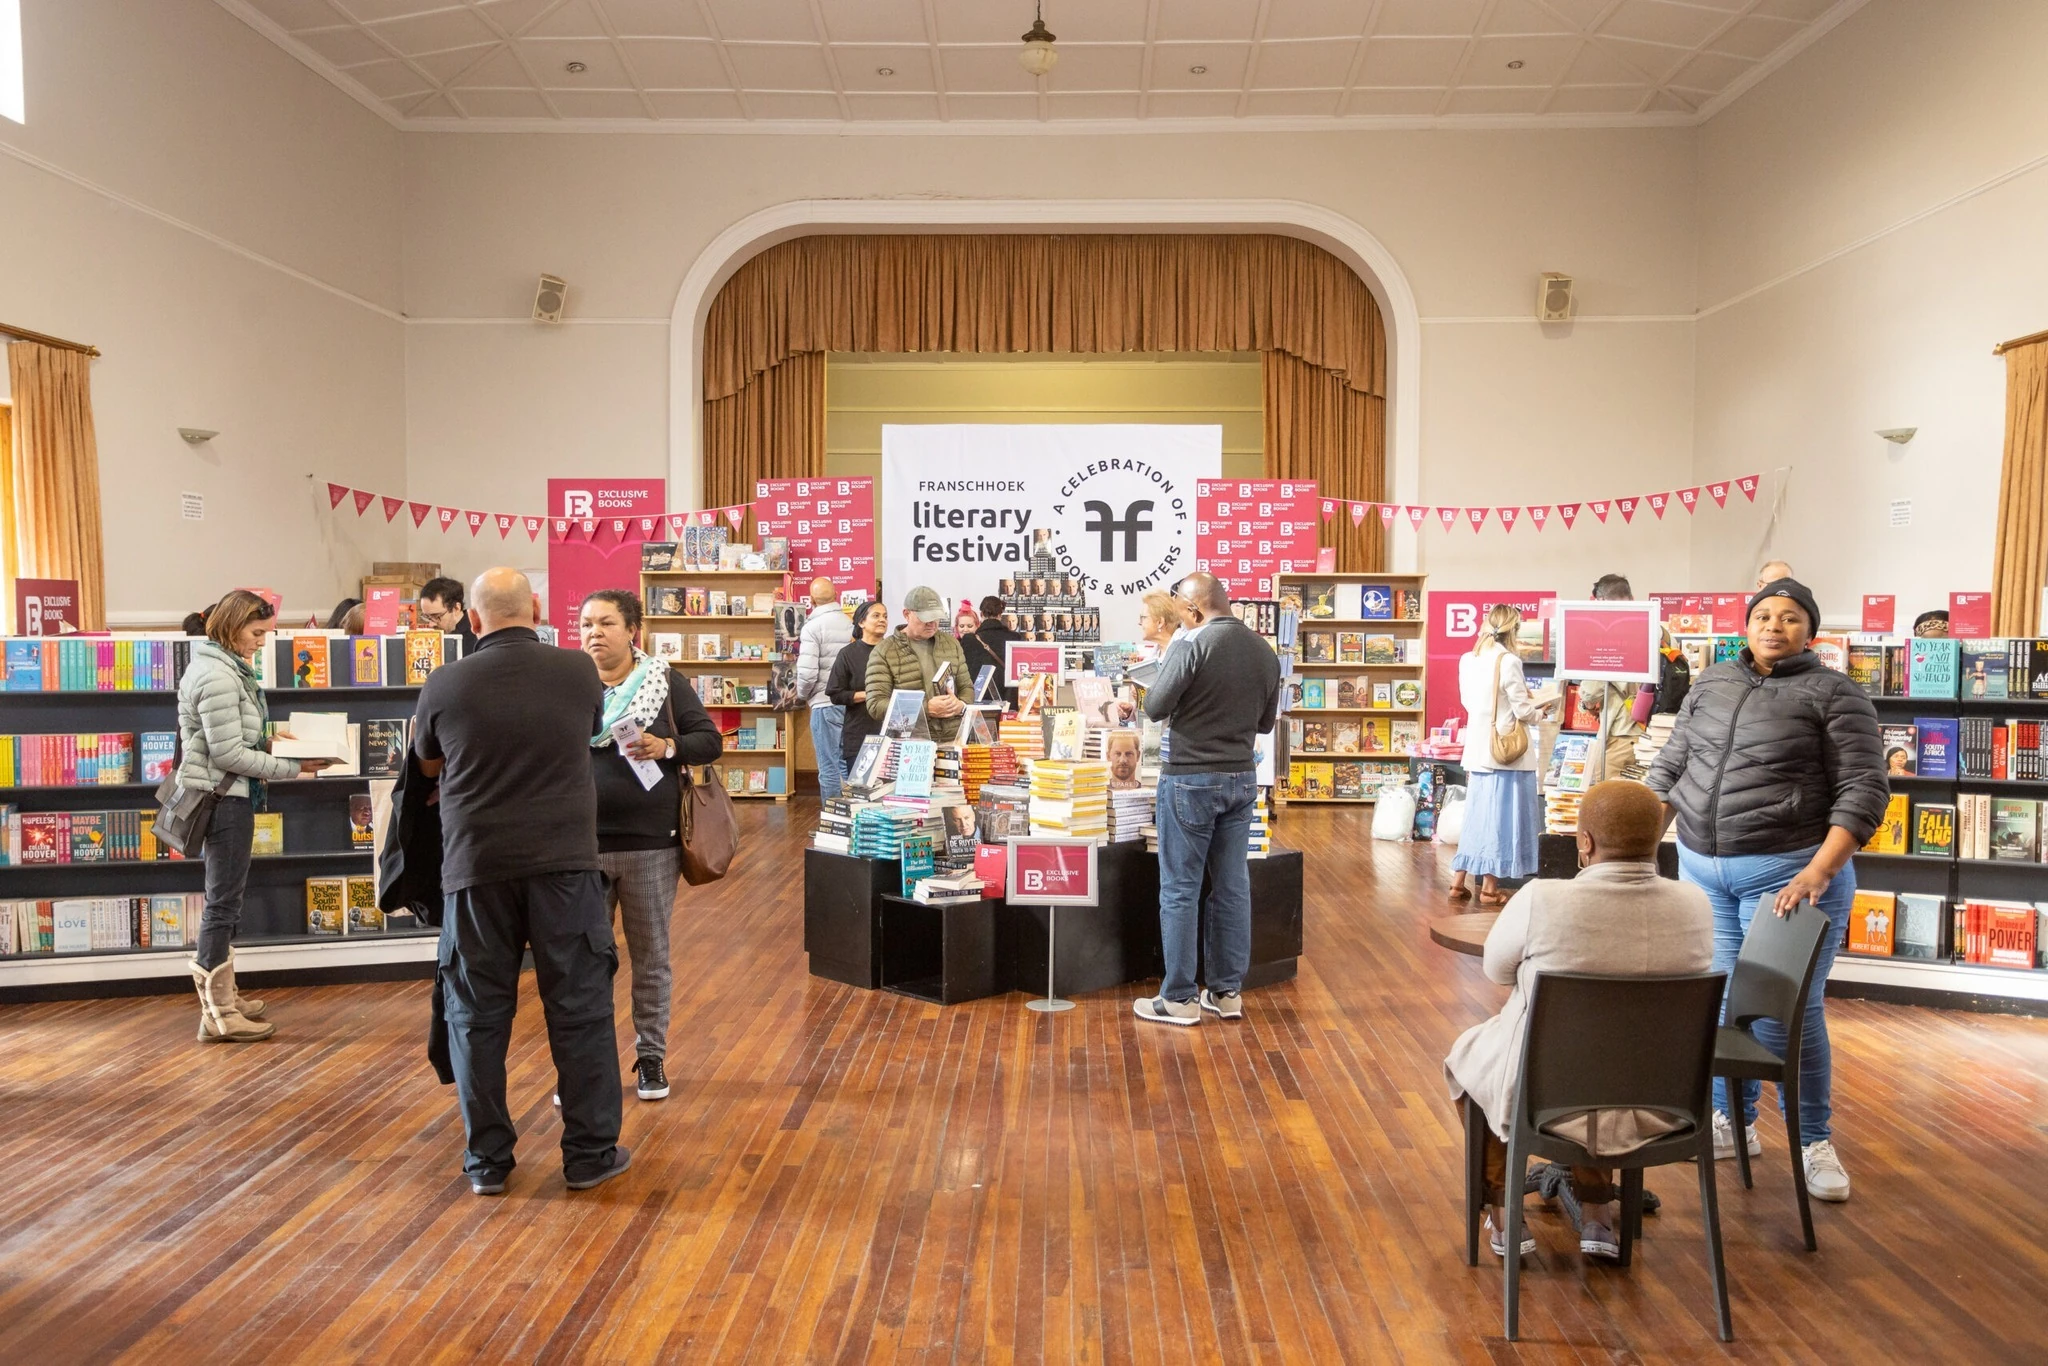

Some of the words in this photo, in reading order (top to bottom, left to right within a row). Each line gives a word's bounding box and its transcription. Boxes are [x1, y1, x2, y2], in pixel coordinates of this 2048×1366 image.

[919, 481, 1025, 492] FRANSCHHOEK
[1053, 503, 1065, 515] A
[1060, 458, 1174, 497] CELEBRATION
[1172, 498, 1187, 521] OF
[598, 490, 648, 498] EXCLUSIVE
[598, 500, 633, 508] BOOKS
[913, 501, 1032, 534] literary
[913, 534, 1031, 562] festival
[1055, 543, 1099, 591] BOOKS
[1104, 583, 1115, 596] &
[1121, 545, 1181, 595] WRITERS
[44, 596, 72, 607] EXCLUSIVE
[44, 609, 63, 620] BOOKS
[413, 637, 435, 648] CLY
[1914, 641, 1927, 651] MY
[1929, 641, 1951, 651] YEAR
[142, 741, 174, 750] HOOVER
[22, 816, 55, 825] HOPELESS
[72, 816, 101, 825] MAYBE
[1919, 814, 1952, 830] FALL
[72, 826, 93, 835] NOW
[949, 840, 957, 848] DE
[958, 838, 982, 846] RUYTER
[22, 850, 56, 859] HOOVER
[74, 848, 105, 857] HOOVER
[313, 897, 337, 905] South
[58, 920, 87, 929] LOVE
[1989, 928, 2032, 952] POWER
